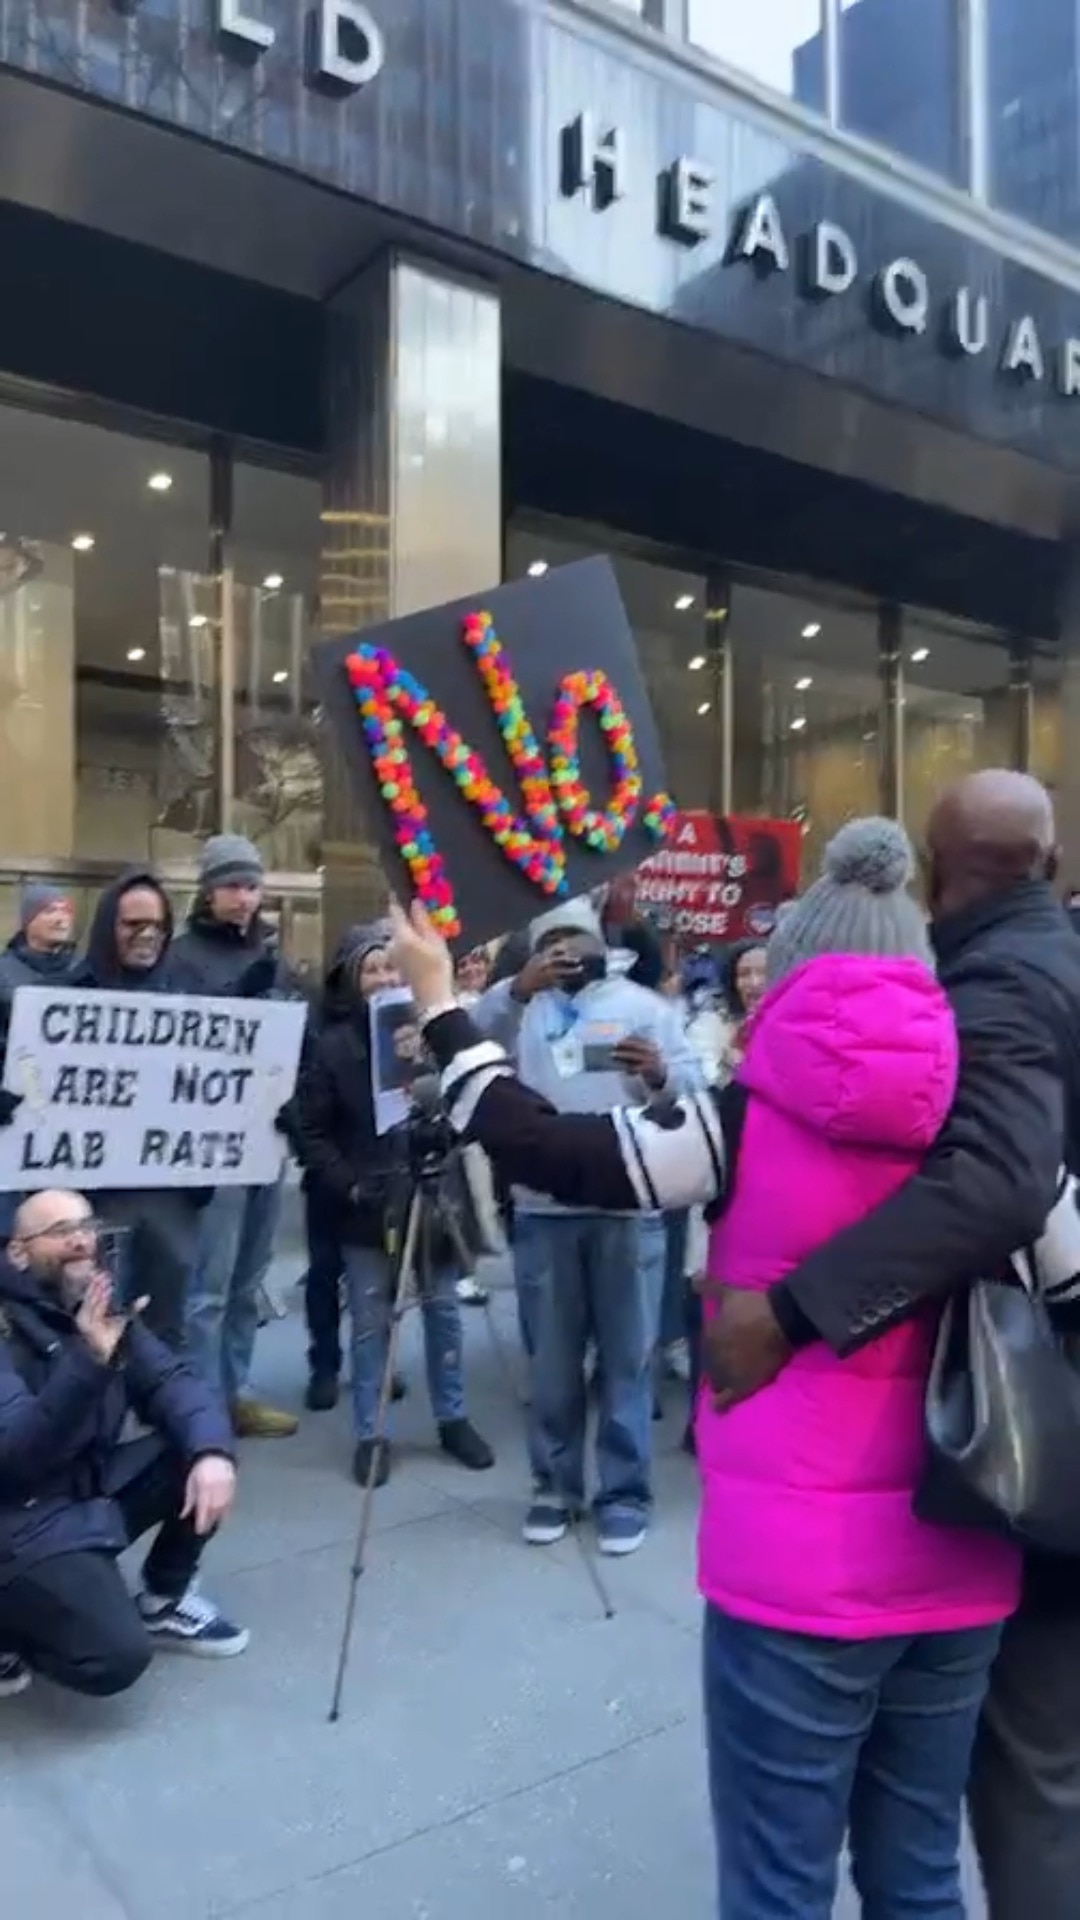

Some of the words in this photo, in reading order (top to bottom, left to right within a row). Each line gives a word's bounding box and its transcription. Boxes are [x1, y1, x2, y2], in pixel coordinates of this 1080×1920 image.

[676, 822, 697, 845] A
[706, 882, 742, 906] TO
[41, 1003, 261, 1056] CHILDREN
[51, 1065, 139, 1107] ARE
[170, 1065, 254, 1105] NOT
[20, 1129, 106, 1171] LAB
[139, 1128, 246, 1169] RATS
